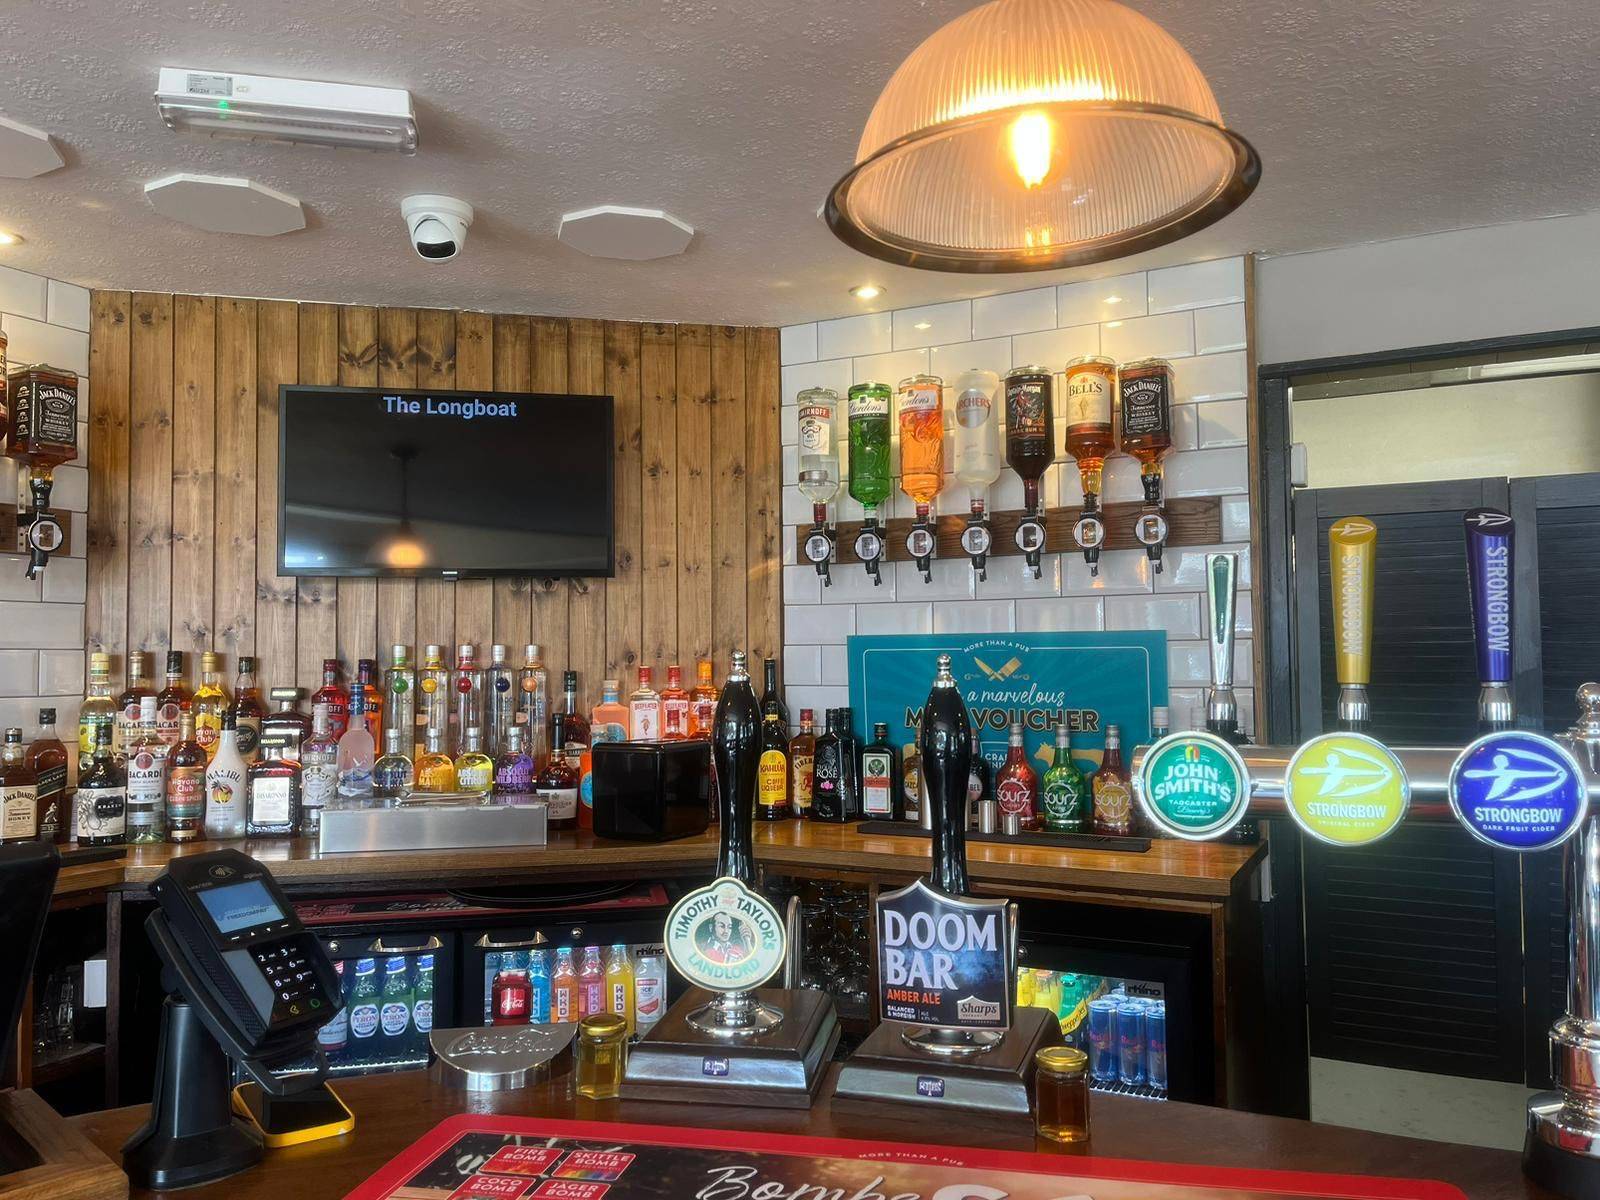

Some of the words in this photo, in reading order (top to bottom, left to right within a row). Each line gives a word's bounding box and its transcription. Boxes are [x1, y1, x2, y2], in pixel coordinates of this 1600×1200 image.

[40, 388, 54, 401] JACK
[1069, 381, 1103, 396] BELL'S
[1123, 383, 1139, 397] JACK
[383, 396, 420, 414] The
[426, 398, 518, 420] Longboat
[1342, 555, 1363, 656] STRONGBOW
[1487, 546, 1510, 652] STRONGBOW
[963, 641, 984, 653] MORE
[985, 639, 1006, 647] THAN
[1015, 643, 1030, 653] PUB
[967, 690, 978, 703] a
[981, 682, 1066, 708] marvelous
[970, 707, 1100, 732] VOUCHER
[1164, 763, 1219, 781] JOHN
[1154, 778, 1232, 803] SMITH'S
[1306, 802, 1387, 818] STRONGBOW
[1474, 807, 1562, 823] STRONGBOW
[675, 894, 719, 939] TIMOTHY
[737, 897, 778, 950] TAYLOR'S
[883, 910, 998, 952] DOOM
[281, 948, 288, 957] 3
[636, 945, 665, 956] rhino
[258, 954, 266, 962] 2
[289, 960, 296, 968] 6
[266, 966, 274, 975] 5
[688, 953, 761, 980] LANDLORD
[886, 948, 959, 991] BAR
[274, 979, 282, 988] 8
[296, 973, 303, 981] 9
[282, 992, 290, 1000] 0
[1128, 982, 1160, 996] rhino
[559, 990, 568, 1016] WKD
[615, 985, 624, 1011] WKD
[886, 988, 920, 1003] AMBER
[922, 992, 941, 1005] ALE
[887, 1005, 915, 1014] BALANCED
[503, 1153, 548, 1161] BOMB
[514, 1147, 548, 1156] FIRE
[573, 1152, 631, 1161] SKITTLE
[575, 1159, 619, 1167] BOMB
[858, 1151, 892, 1159] MORE
[896, 1152, 928, 1160] THAN
[942, 1157, 965, 1167] PUB
[470, 1183, 517, 1193] BOMB
[477, 1177, 524, 1186] COCO
[544, 1188, 593, 1198] BOMB
